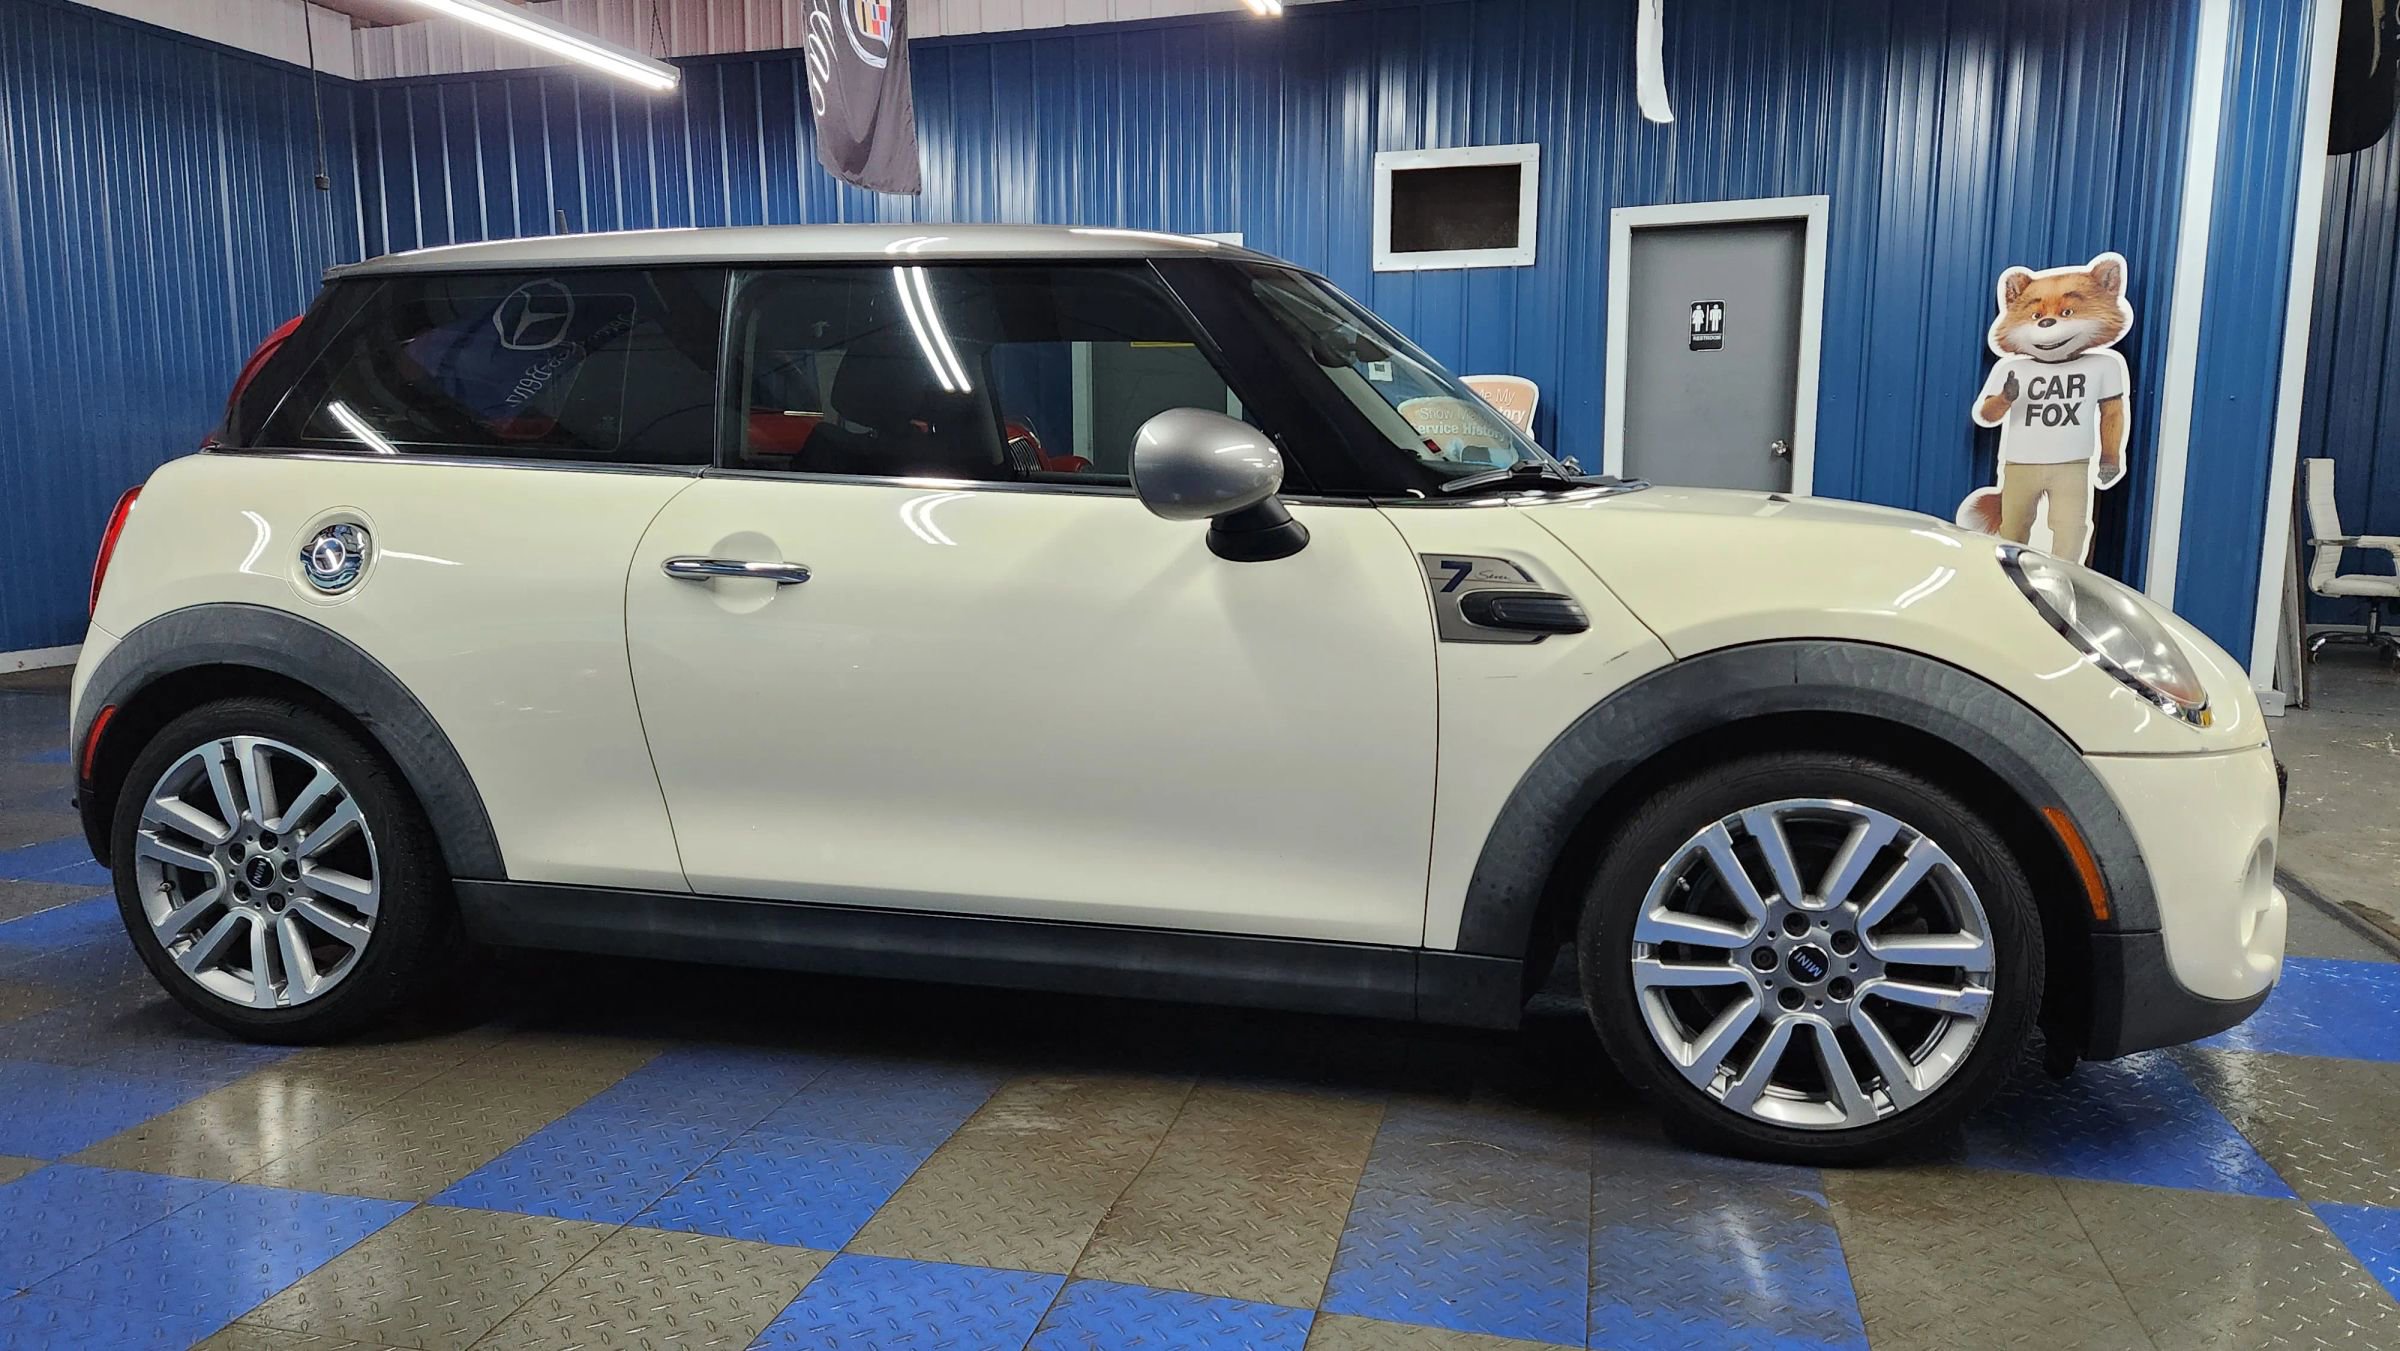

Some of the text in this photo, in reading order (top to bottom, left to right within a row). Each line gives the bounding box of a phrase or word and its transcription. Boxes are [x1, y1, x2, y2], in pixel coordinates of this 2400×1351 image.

[1496, 388, 1516, 408] My
[2027, 373, 2086, 400] CAR
[2025, 402, 2082, 427] FOX
[1440, 560, 1472, 593] 7
[1793, 951, 1823, 977] MINI
